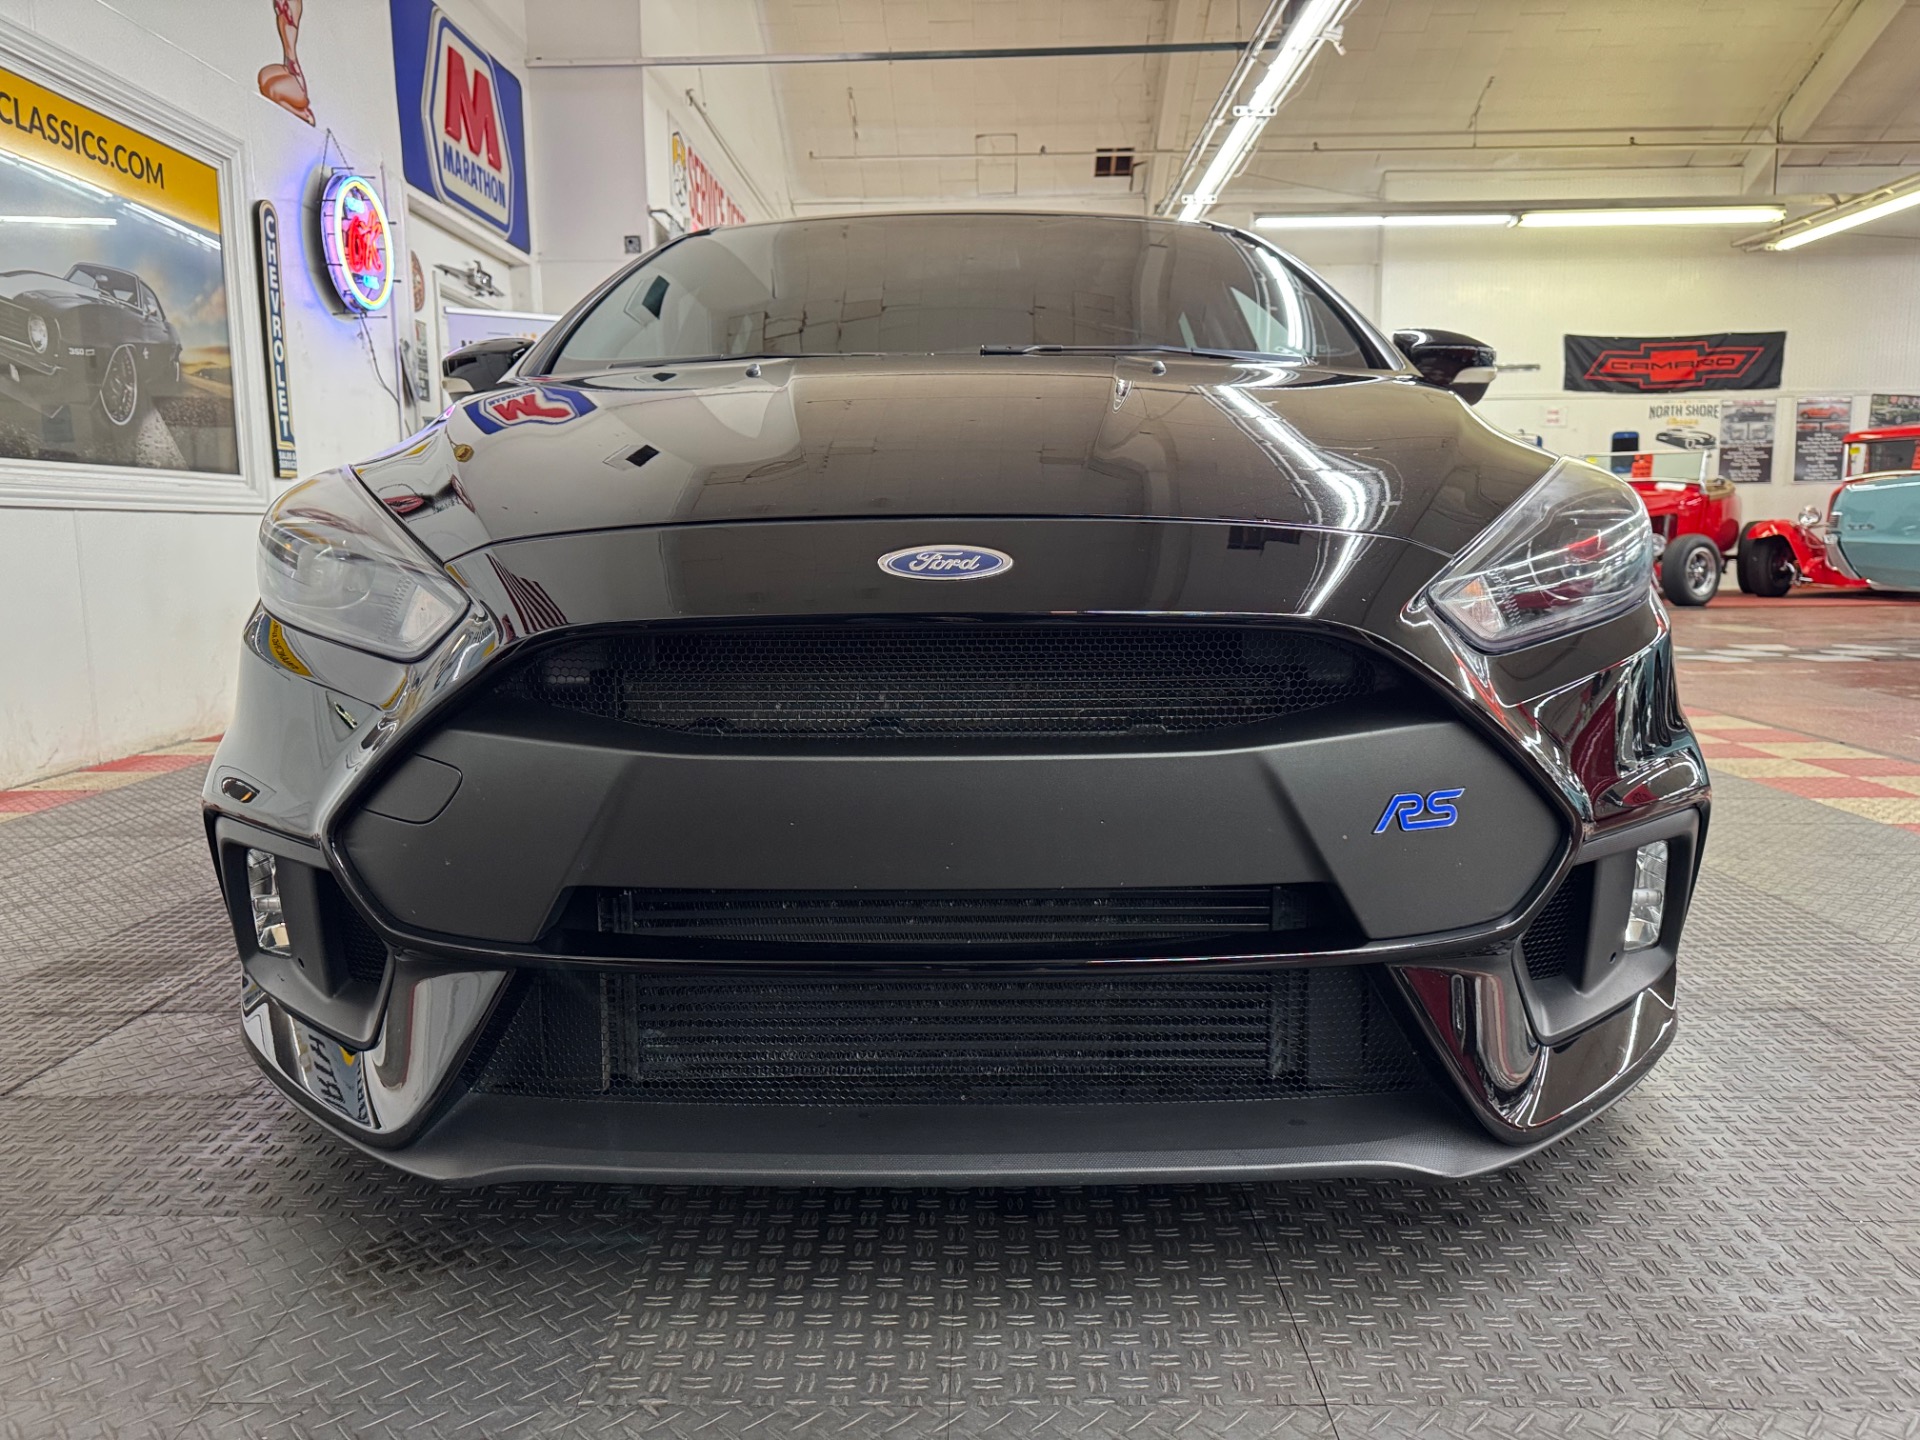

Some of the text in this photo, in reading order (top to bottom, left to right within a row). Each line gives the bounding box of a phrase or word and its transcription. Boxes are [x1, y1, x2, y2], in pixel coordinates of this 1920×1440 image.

[444, 45, 502, 173] M
[0, 91, 165, 190] CLASSICS.COM
[443, 140, 506, 209] MARATHON
[265, 214, 291, 438] CHEVROLET
[68, 347, 85, 356] 350
[1611, 357, 1736, 370] CAMARO
[1648, 404, 1720, 419] NORTH SHORE
[908, 551, 982, 571] Ford
[1371, 787, 1466, 834] RS
